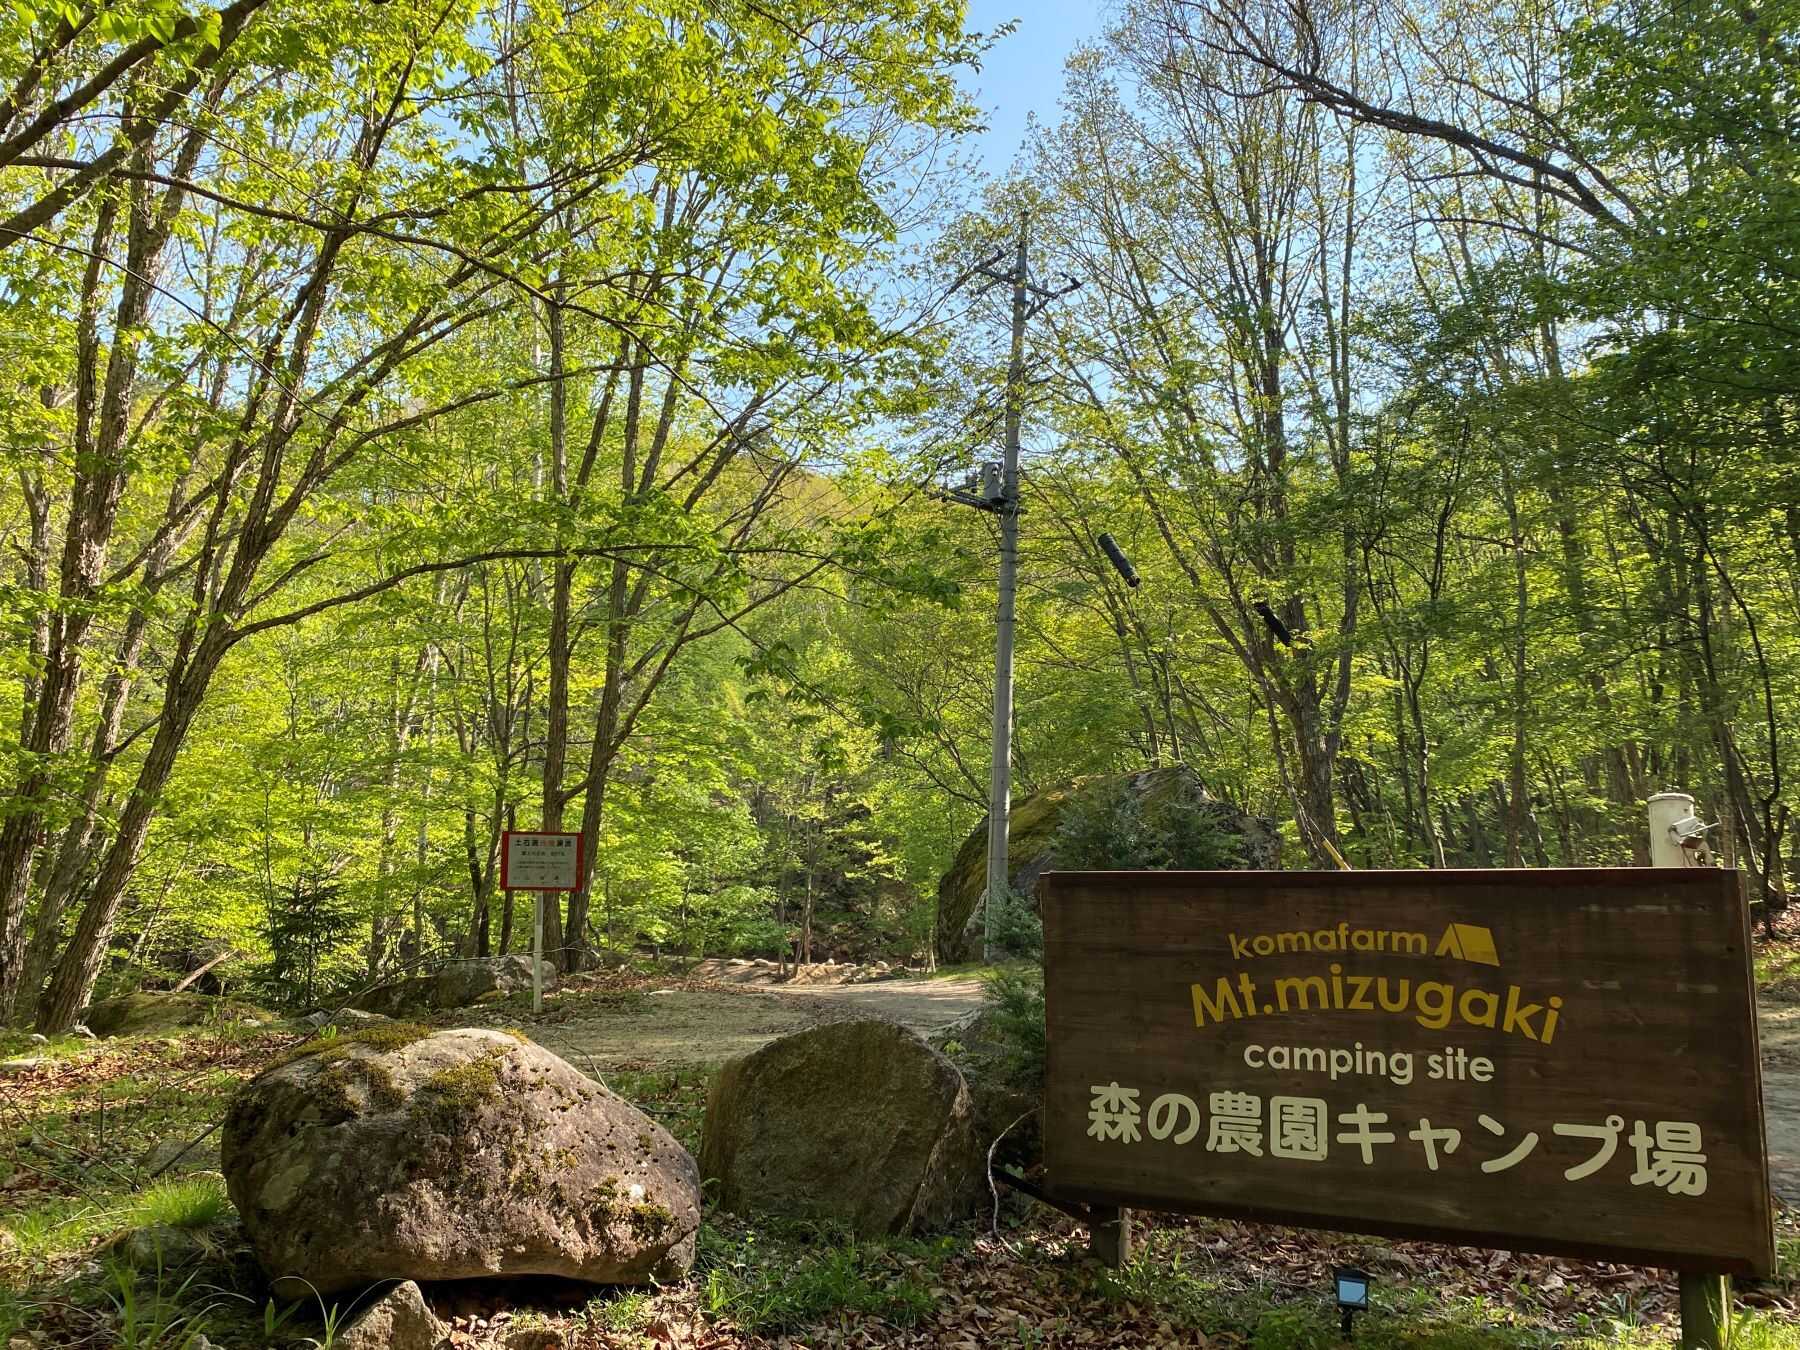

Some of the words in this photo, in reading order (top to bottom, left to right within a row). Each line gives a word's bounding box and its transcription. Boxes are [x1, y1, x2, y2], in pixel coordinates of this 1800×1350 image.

[1229, 922, 1428, 959] komafarm
[1191, 963, 1563, 1044] Mt.mizugaki
[1243, 1041, 1415, 1085] camping
[1427, 1045, 1495, 1082] site
[1086, 1081, 1708, 1197] 森の農園キャンプ場
